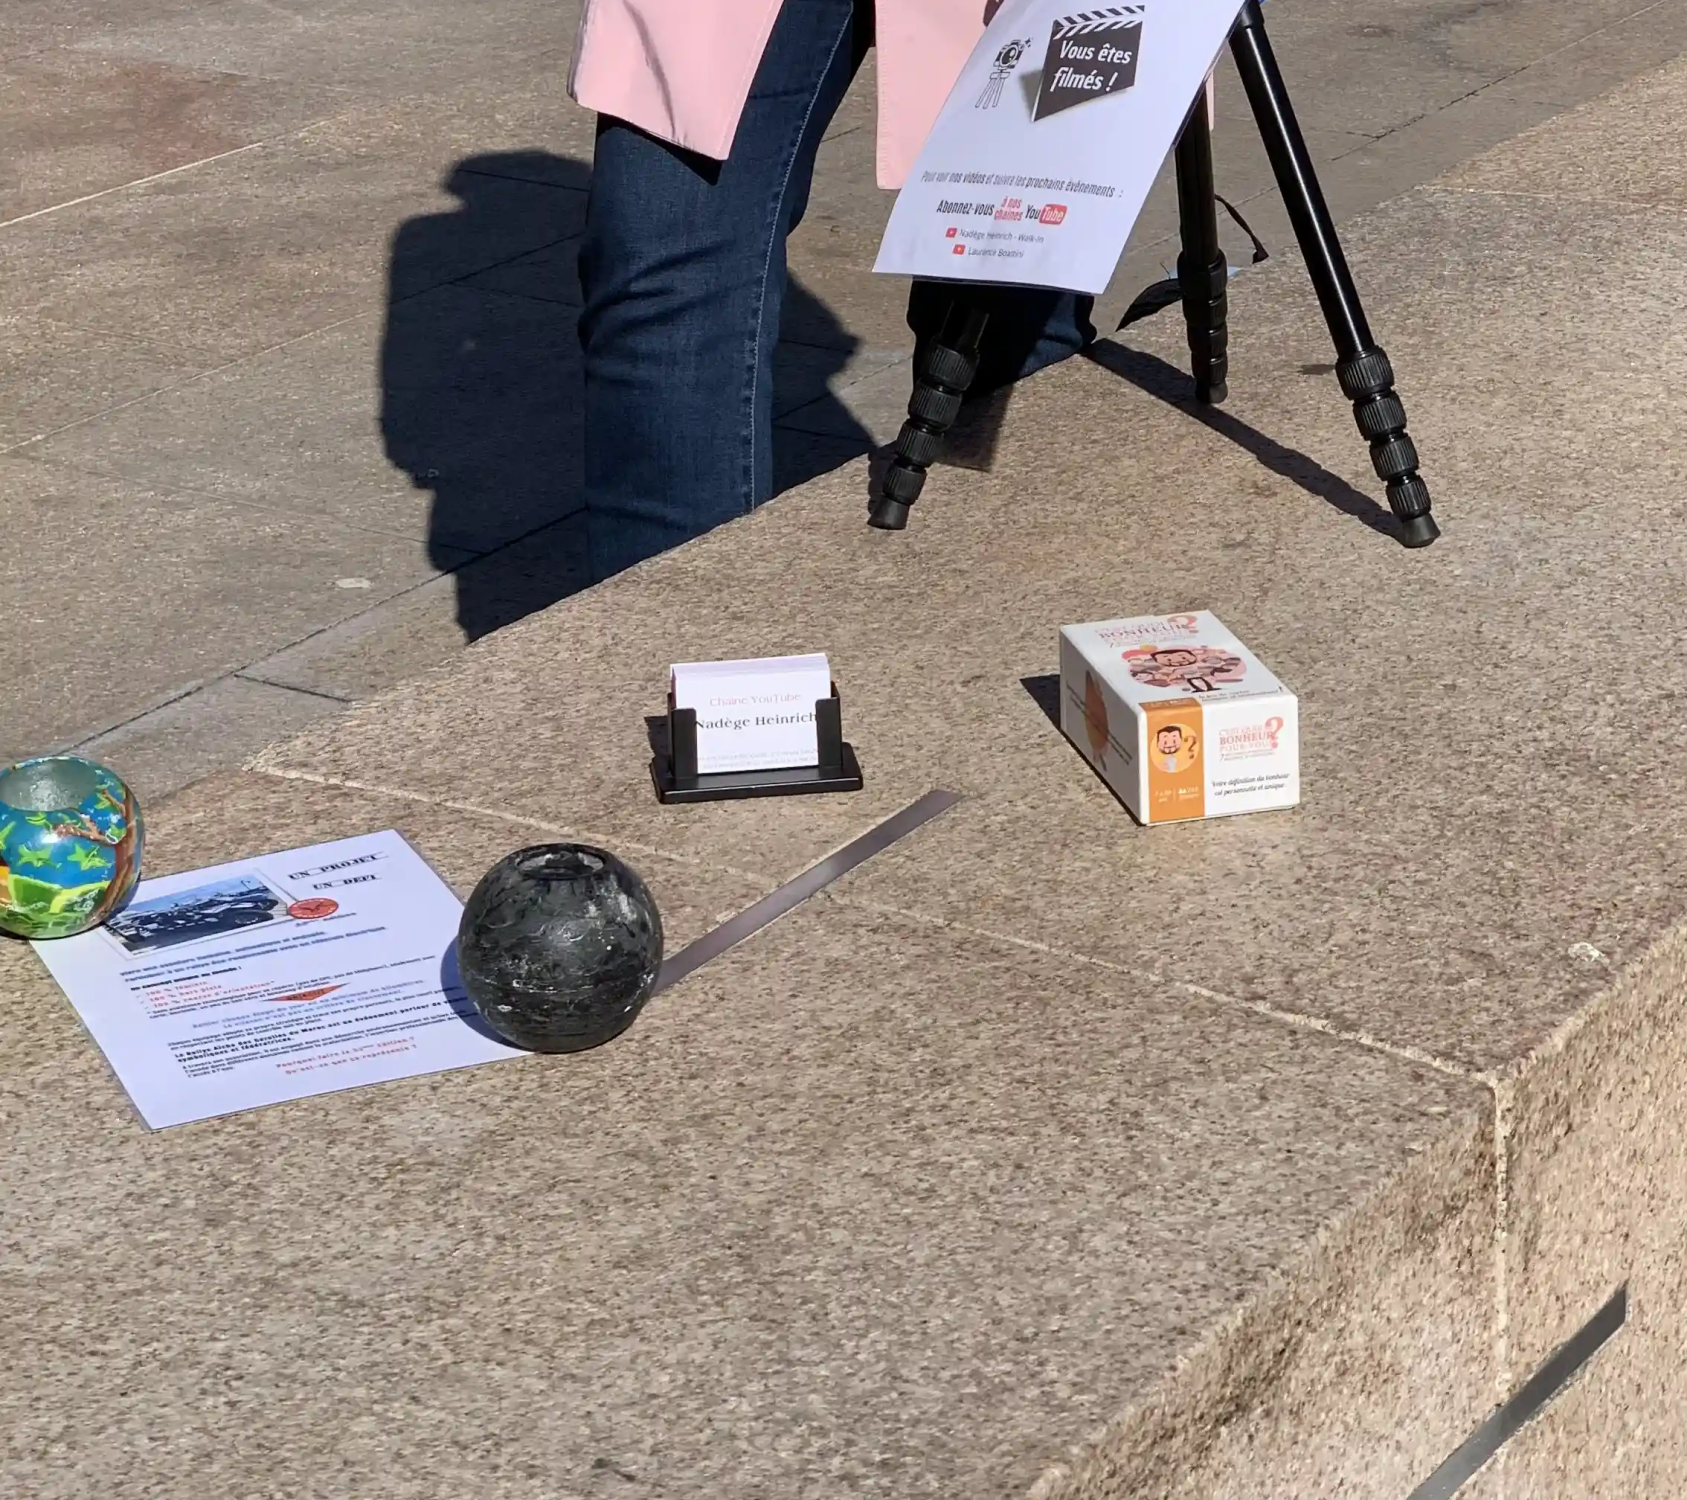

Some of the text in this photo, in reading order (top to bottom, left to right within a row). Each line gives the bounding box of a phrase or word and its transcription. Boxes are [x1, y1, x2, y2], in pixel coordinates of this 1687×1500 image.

[1059, 40, 1132, 64] Vous êtes
[1050, 67, 1118, 92] filmés !
[963, 171, 986, 184] vidéos
[1025, 176, 1065, 191] prochains
[936, 200, 995, 216] Abonnez-vous
[750, 693, 802, 704] YouTube
[696, 717, 750, 730] Nadège
[1220, 731, 1274, 746] BONHEUR
[288, 854, 378, 881] UN PROJET
[313, 881, 334, 890] UN
